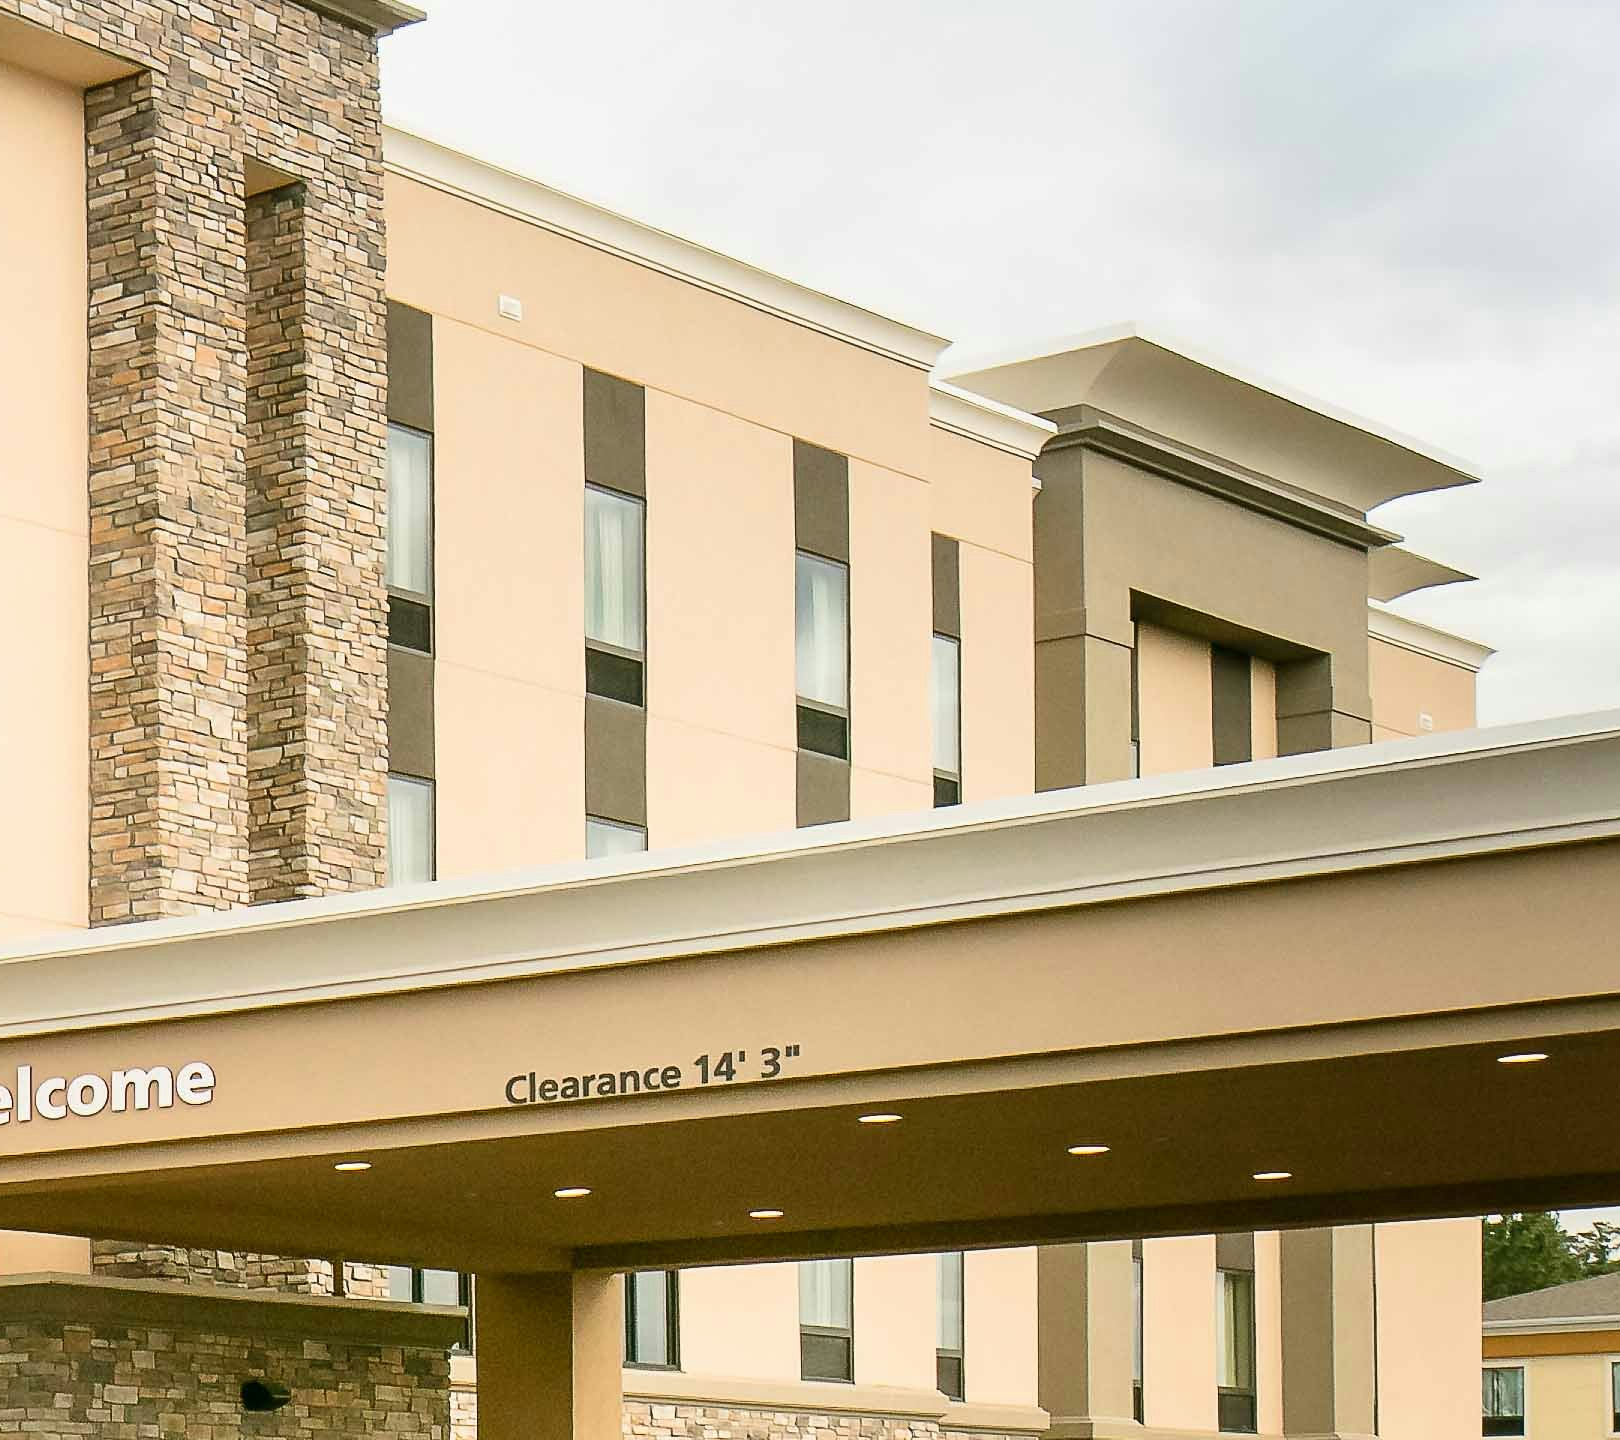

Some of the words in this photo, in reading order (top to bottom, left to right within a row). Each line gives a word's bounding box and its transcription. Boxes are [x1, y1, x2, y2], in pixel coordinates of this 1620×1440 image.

[504, 1064, 682, 1104] Clearance
[693, 1050, 746, 1085] 14'
[760, 1044, 800, 1079] 3"
